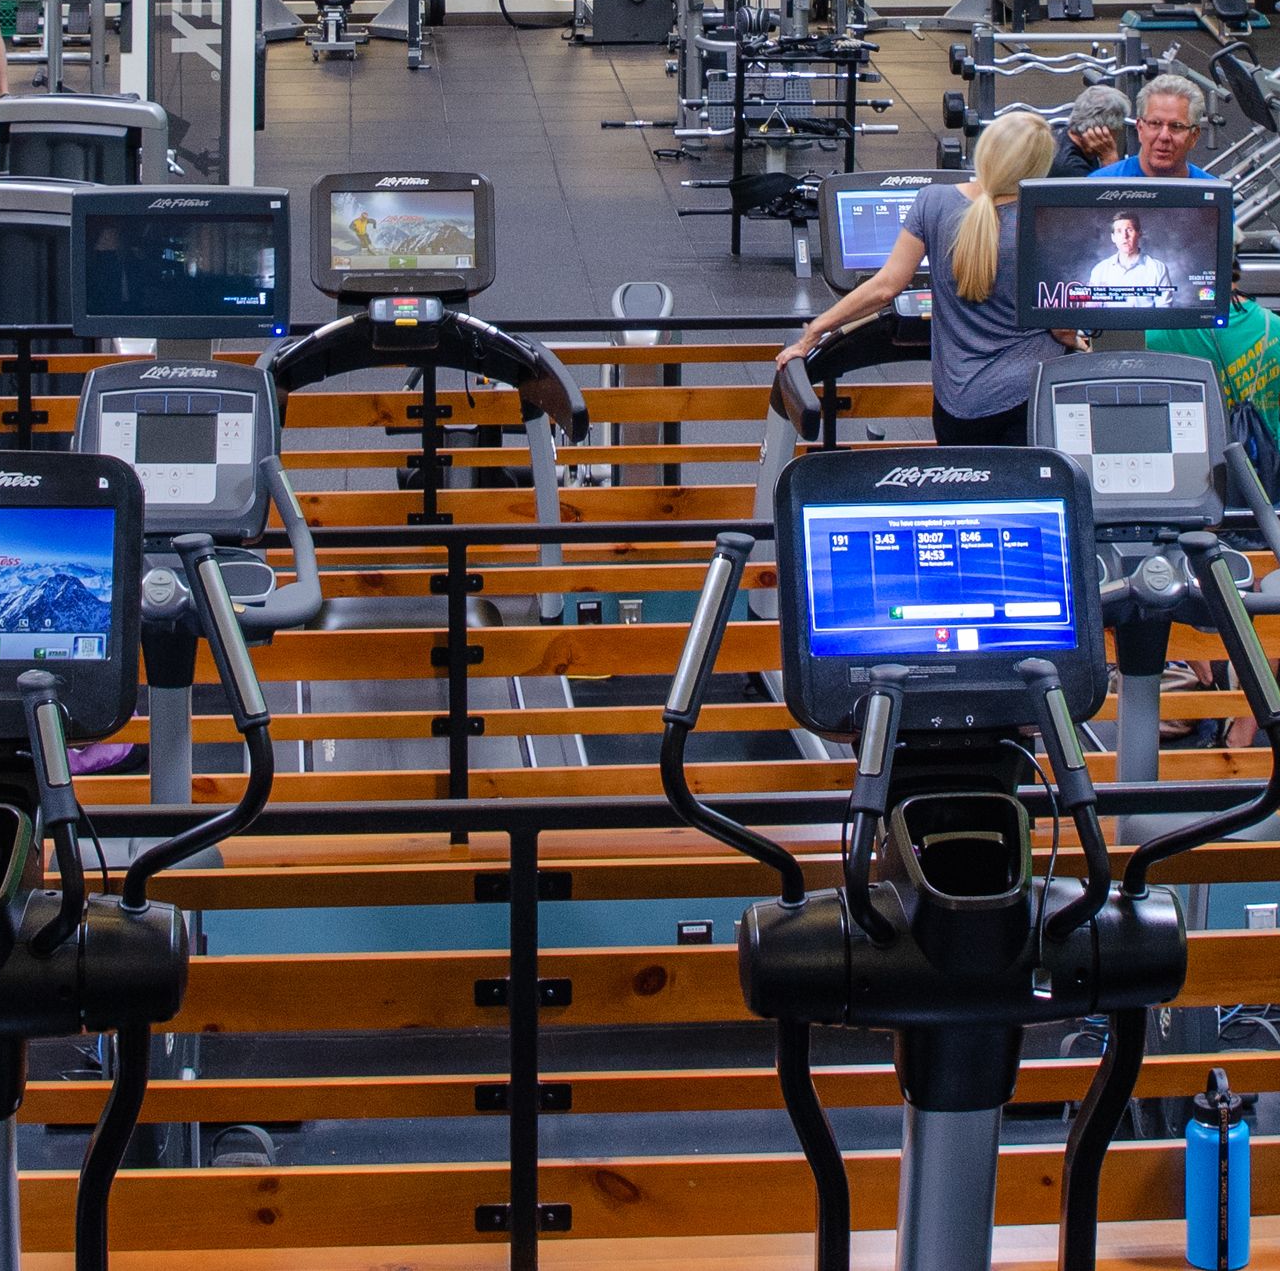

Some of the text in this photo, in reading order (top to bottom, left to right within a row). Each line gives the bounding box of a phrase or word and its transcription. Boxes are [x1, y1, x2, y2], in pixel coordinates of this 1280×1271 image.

[832, 535, 849, 546] 191
[875, 533, 896, 545] 3.43
[917, 532, 944, 544] 30:07
[960, 531, 981, 543] 8:46
[919, 550, 945, 562] 34:53
